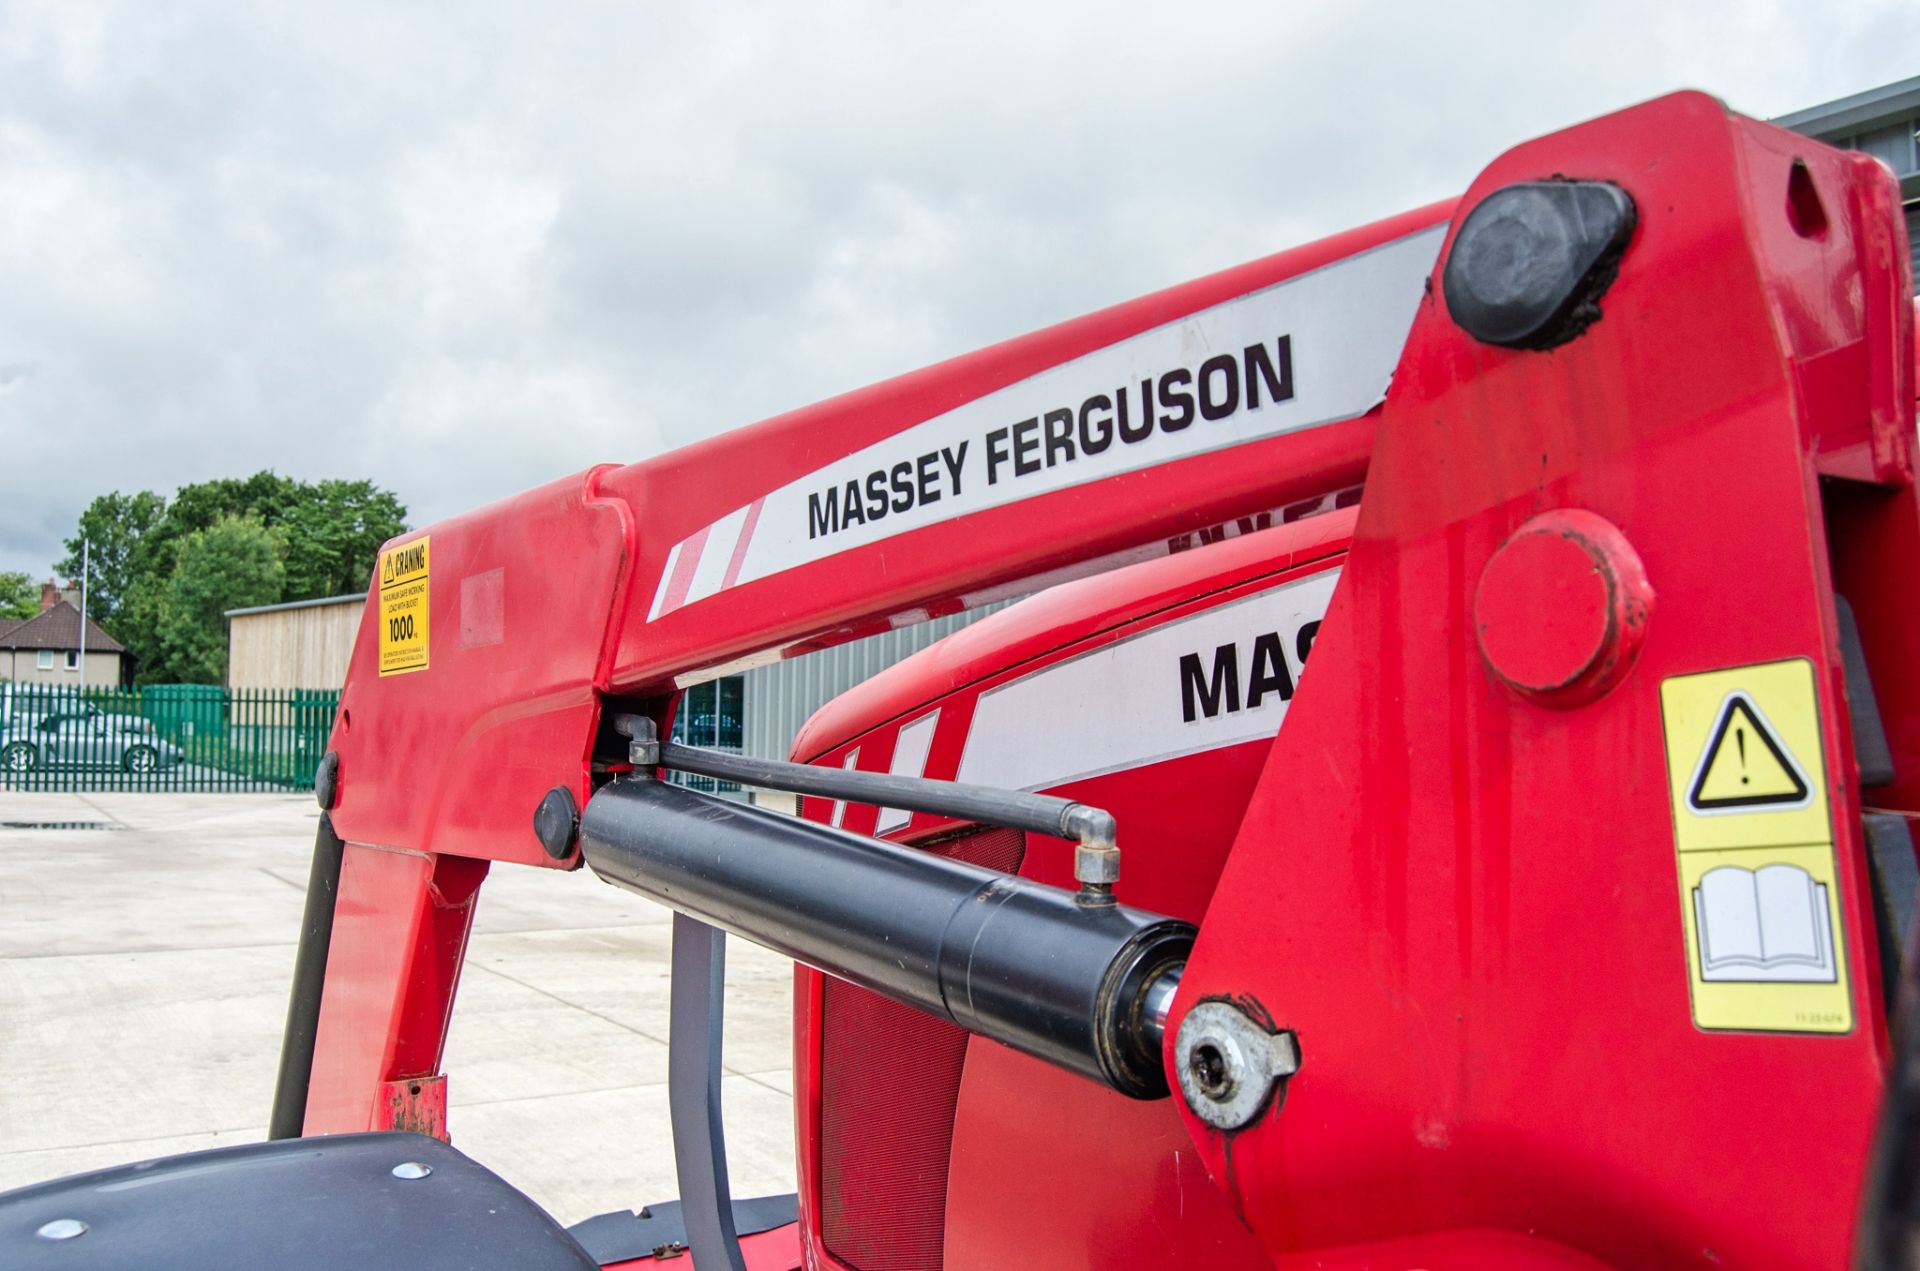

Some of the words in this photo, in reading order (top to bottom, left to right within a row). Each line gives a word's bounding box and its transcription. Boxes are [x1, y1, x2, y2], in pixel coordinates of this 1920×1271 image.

[808, 440, 969, 539] MASSEY
[985, 334, 1295, 486] FERGUSON
[396, 544, 424, 577] CRANING
[390, 614, 413, 642] 1000
